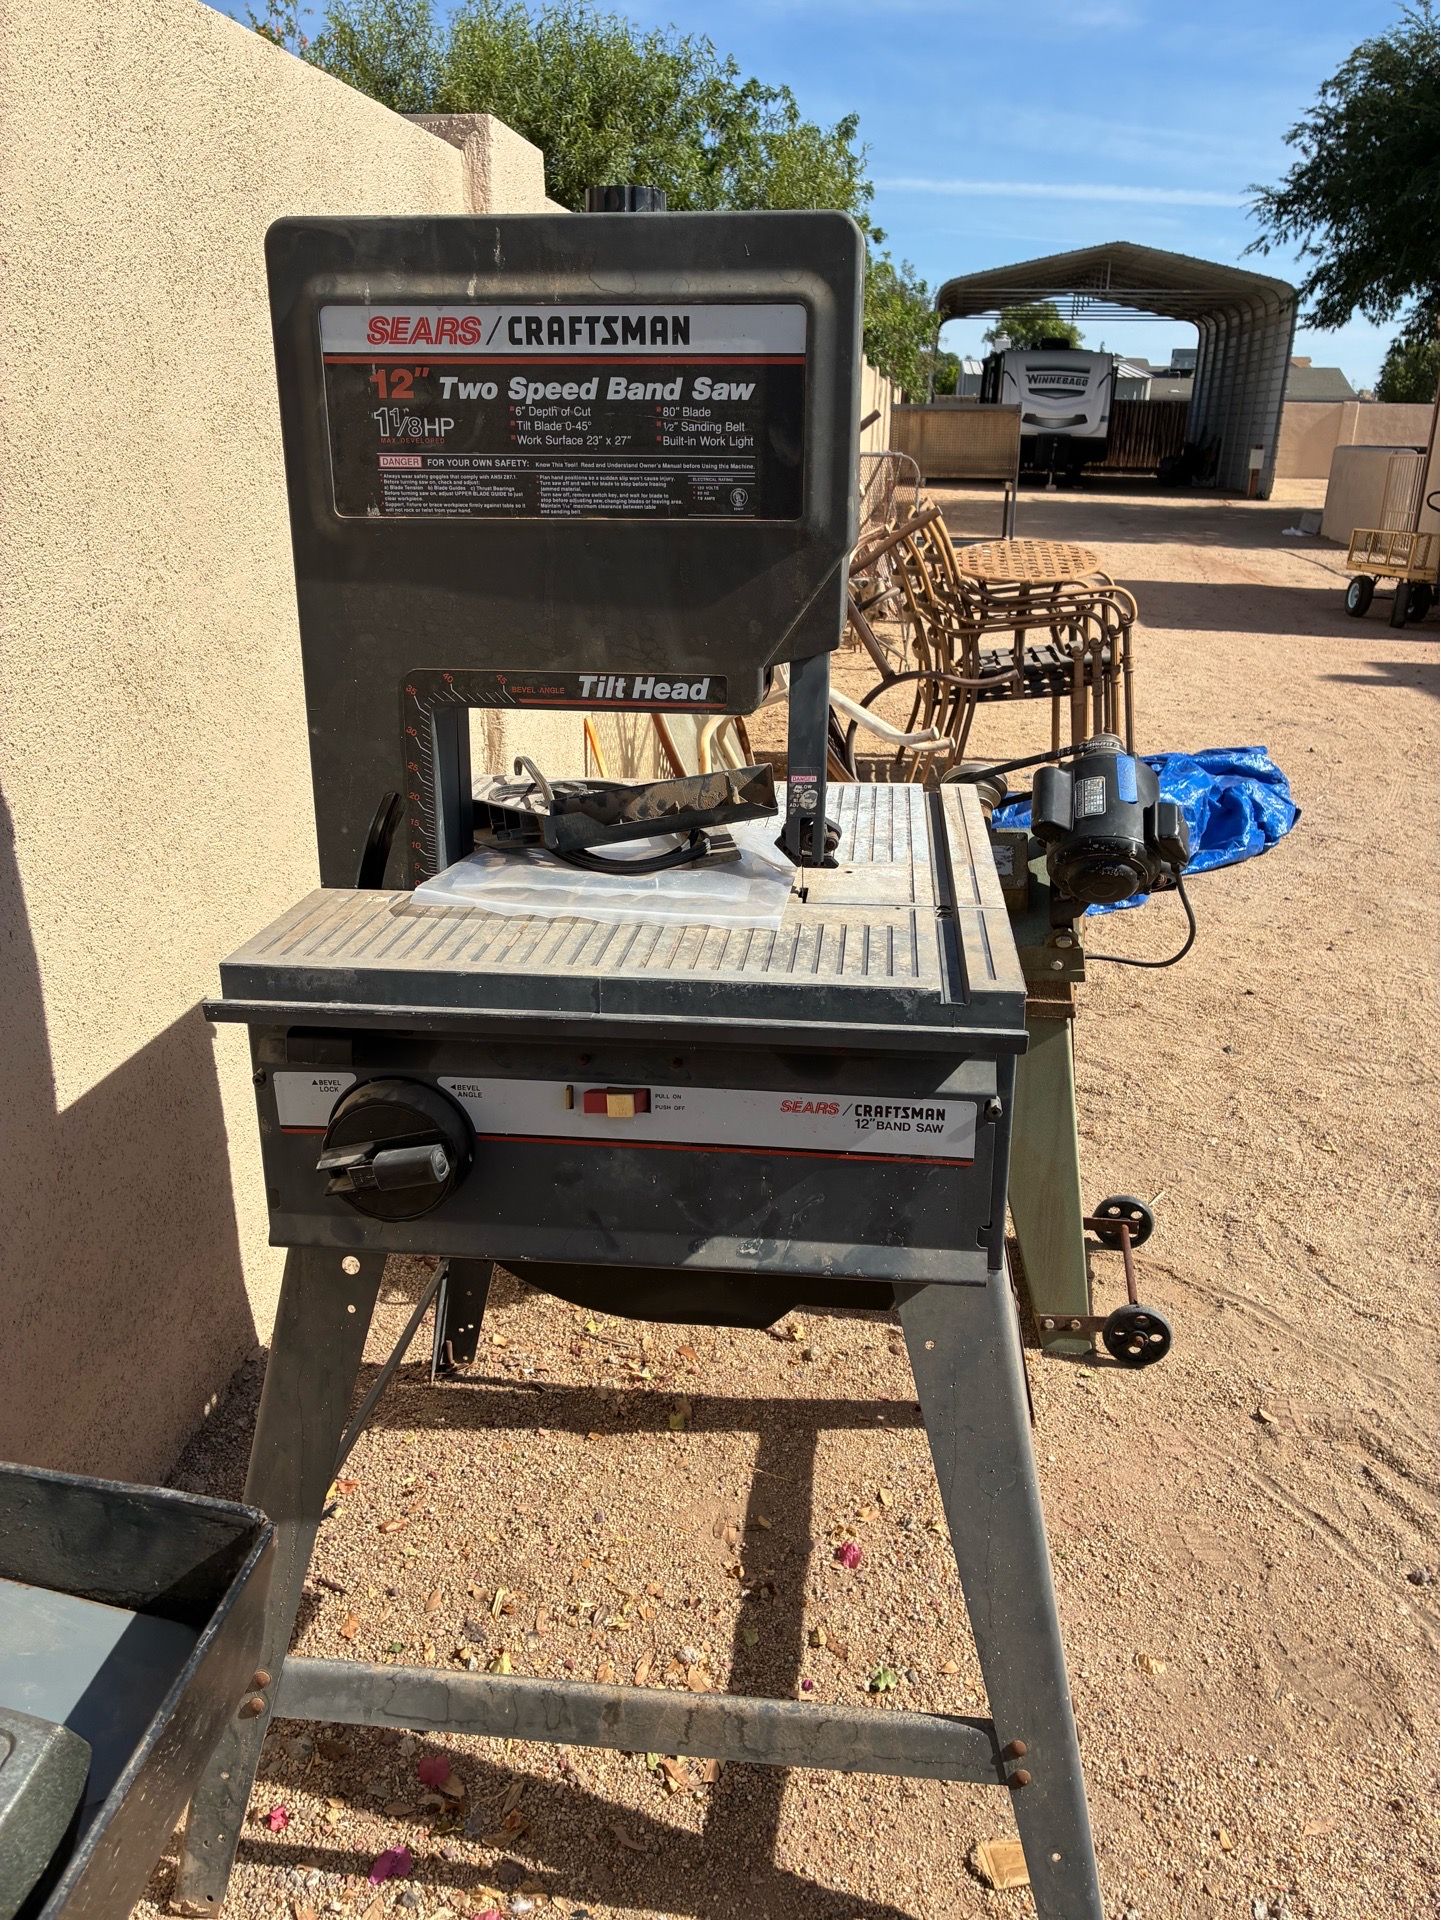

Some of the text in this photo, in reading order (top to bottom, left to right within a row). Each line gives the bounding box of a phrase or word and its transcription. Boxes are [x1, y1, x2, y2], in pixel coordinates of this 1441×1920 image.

[367, 316, 482, 345] SEARS
[508, 316, 690, 345] CRAFTSMAN
[370, 367, 756, 404] 12" Two Speed Band Saw
[1026, 375, 1089, 386] WINNEBAGO
[515, 406, 591, 418] 6" Depth of Cut
[663, 407, 711, 417] 80" Blade
[516, 420, 530, 430] Tilt
[535, 421, 562, 431] Blade
[681, 422, 721, 434] Sanding
[726, 422, 745, 432] Belt
[517, 435, 542, 445] Work
[545, 435, 583, 445] Surface
[587, 435, 603, 445] 23"
[615, 436, 631, 445] 27"
[663, 436, 753, 448] Built-in Work Light
[382, 458, 420, 466] DANGER
[443, 673, 454, 683] 40
[496, 673, 507, 685] 45
[406, 684, 417, 695] 35
[578, 675, 710, 701] Tilt Head
[406, 726, 417, 736] 30
[408, 762, 418, 771] 25
[409, 792, 420, 801] 20
[410, 818, 420, 826] 15
[780, 1100, 840, 1116] SEARS
[855, 1104, 946, 1121] CRAFTSMAN
[877, 1121, 911, 1132] BAND
[916, 1123, 944, 1133] SAW
